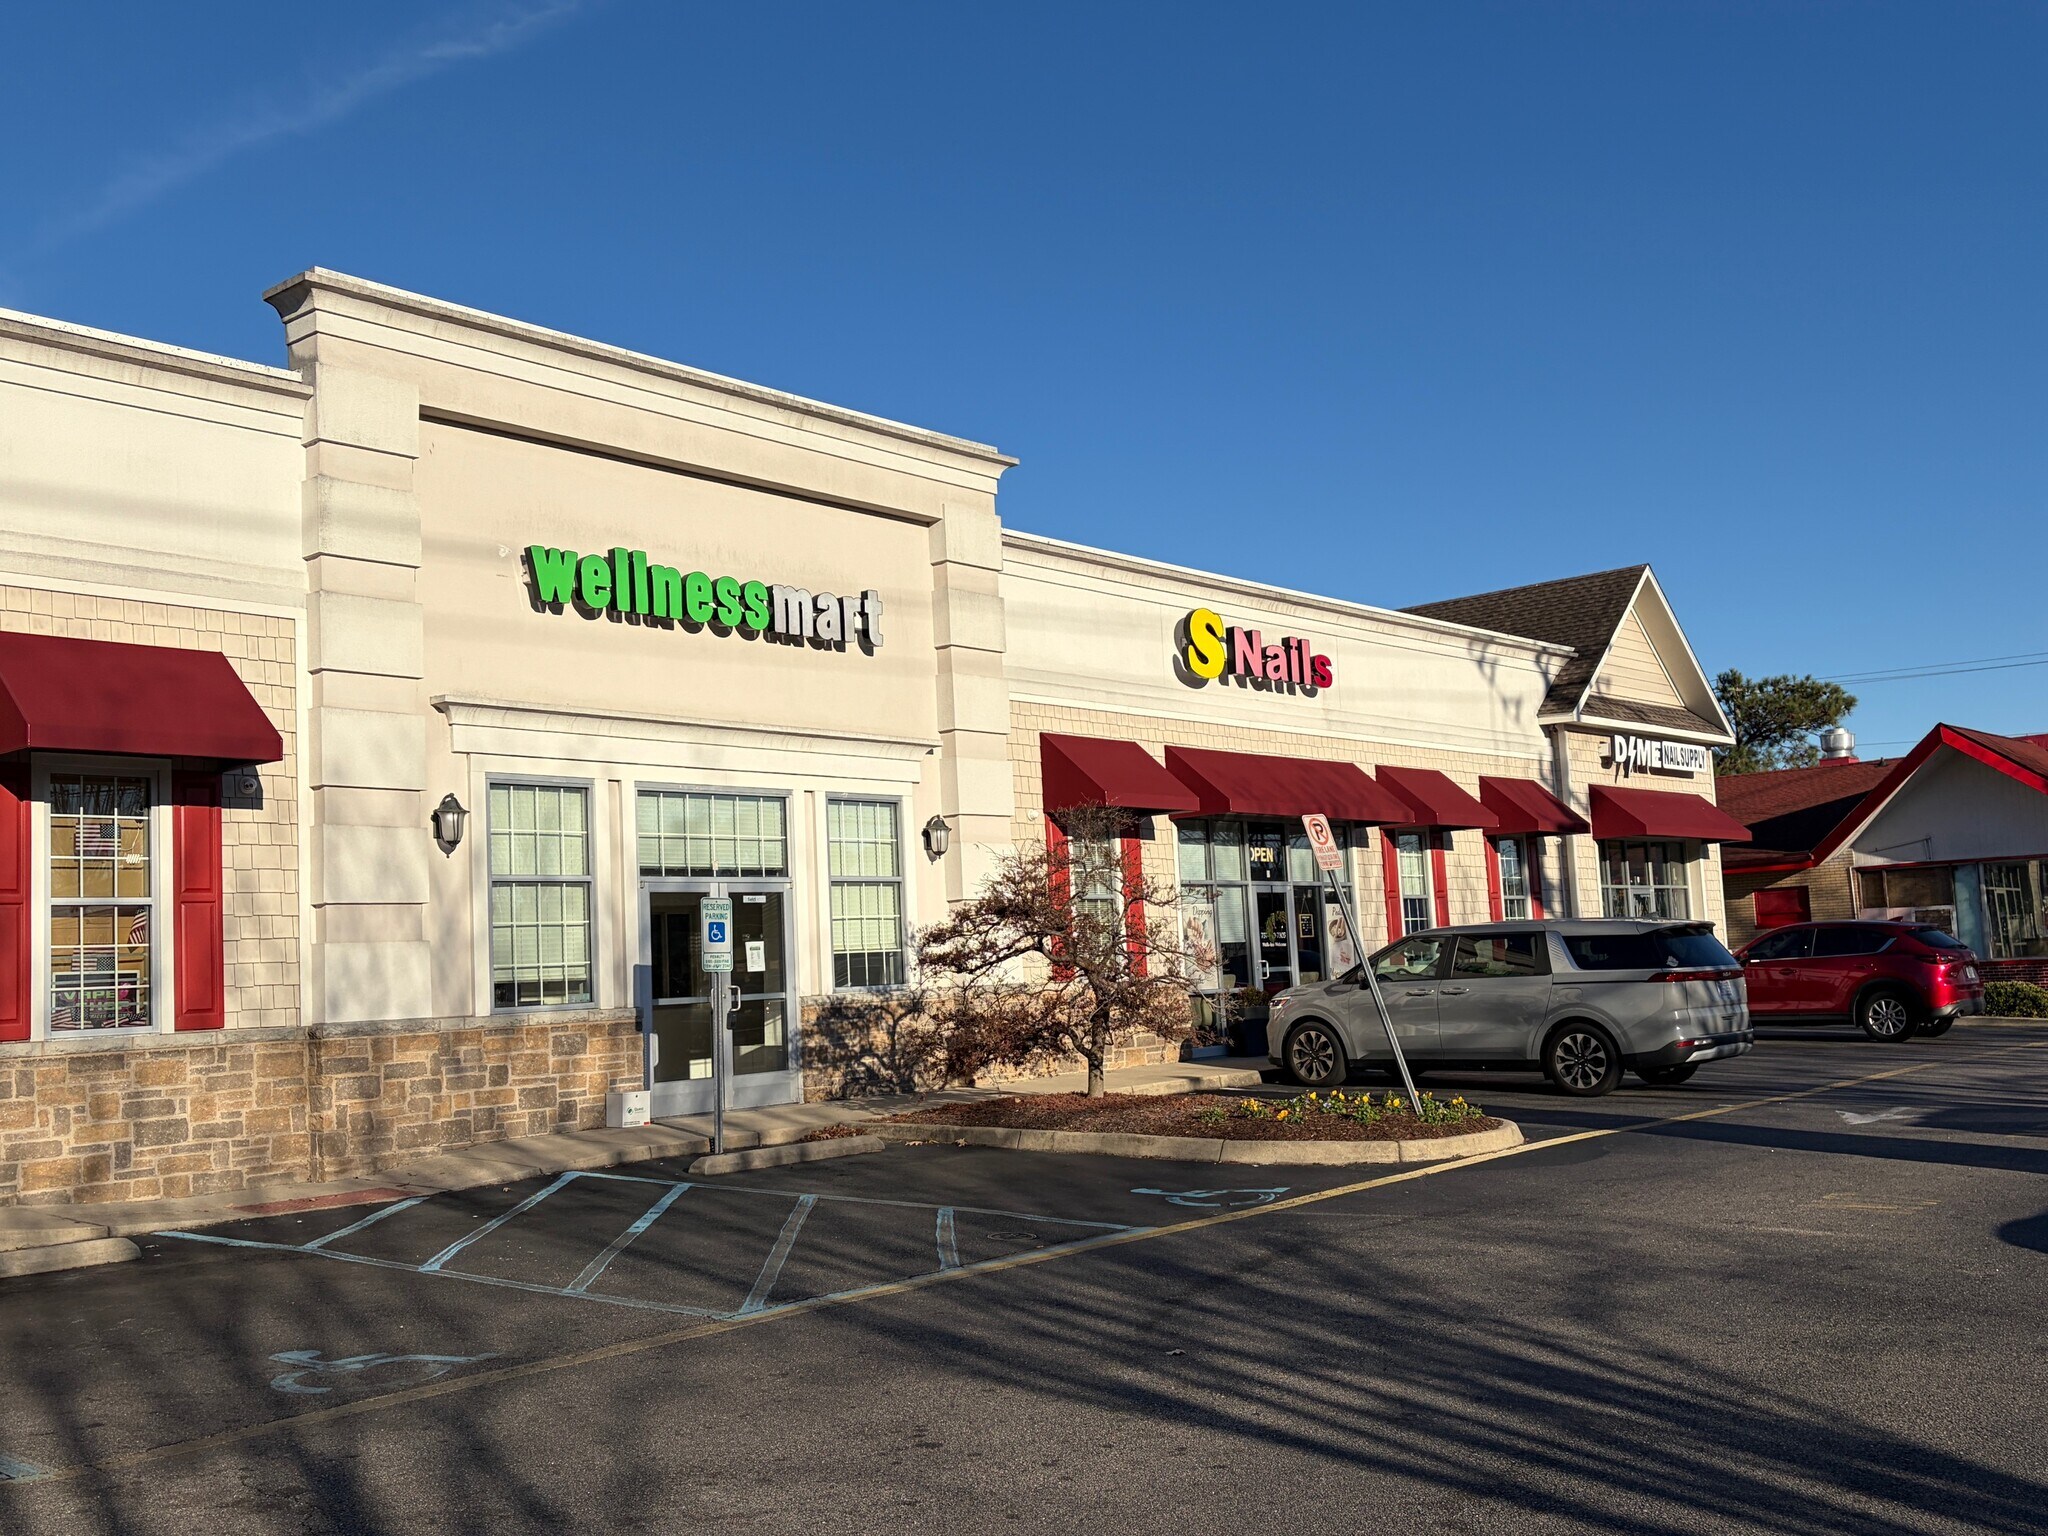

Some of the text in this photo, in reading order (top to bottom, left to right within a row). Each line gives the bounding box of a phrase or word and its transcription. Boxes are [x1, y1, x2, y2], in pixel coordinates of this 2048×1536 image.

[1185, 607, 1333, 688] S Nails
[1663, 744, 1680, 766] NAIL
[1680, 748, 1705, 770] SUPPLY
[703, 903, 730, 911] RESERVED
[705, 912, 728, 920] PARKING
